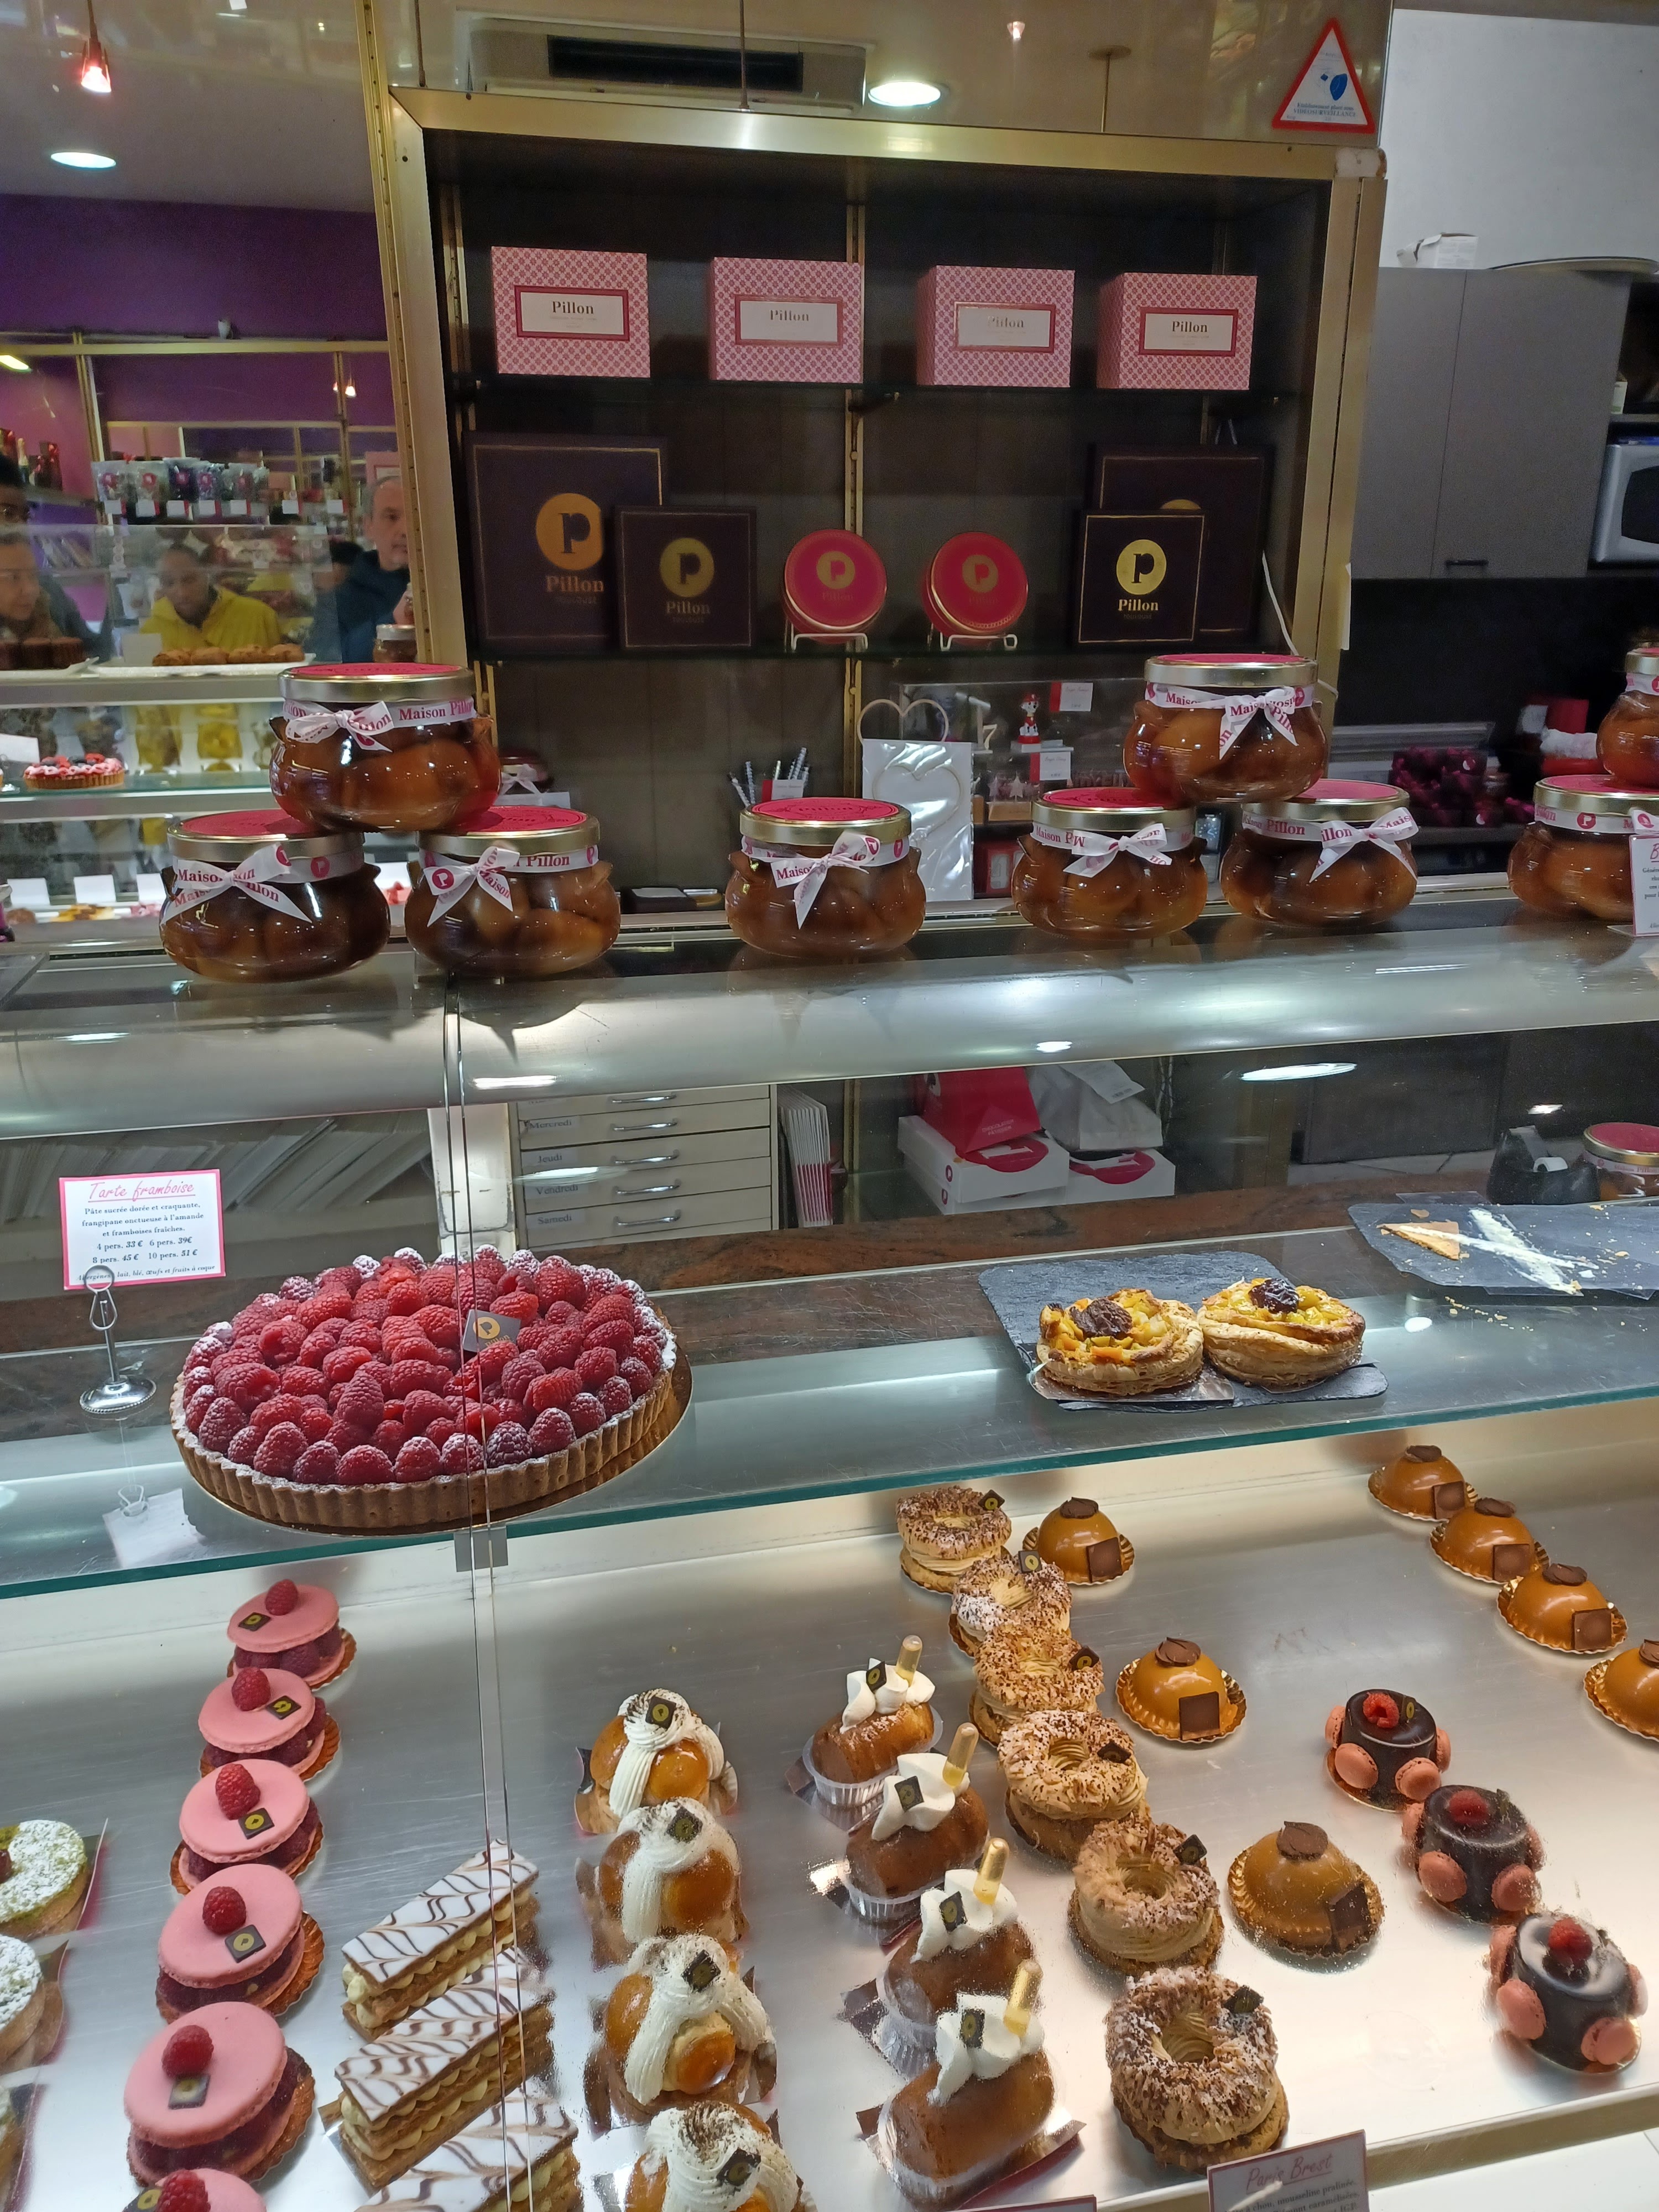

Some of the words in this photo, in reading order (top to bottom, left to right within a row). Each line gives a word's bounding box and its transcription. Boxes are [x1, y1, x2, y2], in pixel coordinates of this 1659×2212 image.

[552, 301, 593, 314] Pillon
[770, 310, 809, 321] Pillon
[1172, 321, 1208, 332] Pillon
[546, 575, 604, 592] Pillon
[666, 601, 711, 614] Pillon
[1118, 599, 1159, 611] Pillon
[398, 708, 446, 721] Maison
[1266, 818, 1306, 836] Pillon
[1321, 827, 1353, 842] illon
[526, 855, 570, 867] Pillon
[529, 1119, 572, 1129] Mercredi
[538, 1153, 562, 1164] Jeudi
[90, 1182, 127, 1199] Tarte
[133, 1180, 194, 1202] framboise
[536, 1184, 578, 1195] Vendredi
[105, 1206, 128, 1214] sucrée
[161, 1202, 201, 1212] craquante,
[82, 1218, 123, 1228] frangipane
[170, 1213, 204, 1221] l'amande
[538, 1214, 572, 1224] Samedi
[112, 1227, 152, 1236] framboises
[154, 1225, 185, 1234] fraîches.
[97, 1243, 102, 1251] 4
[104, 1243, 124, 1252] pers.
[156, 1239, 176, 1248] pers.
[100, 1256, 119, 1265] pers.
[160, 1252, 179, 1261] pers.
[117, 1270, 131, 1279] lait,
[172, 1266, 190, 1275] fruits
[1246, 2166, 1284, 2190] Paris
[1290, 2153, 1333, 2180] Brest
[1277, 2188, 1321, 2205] mousseline
[1323, 2179, 1354, 2197] pralinée
